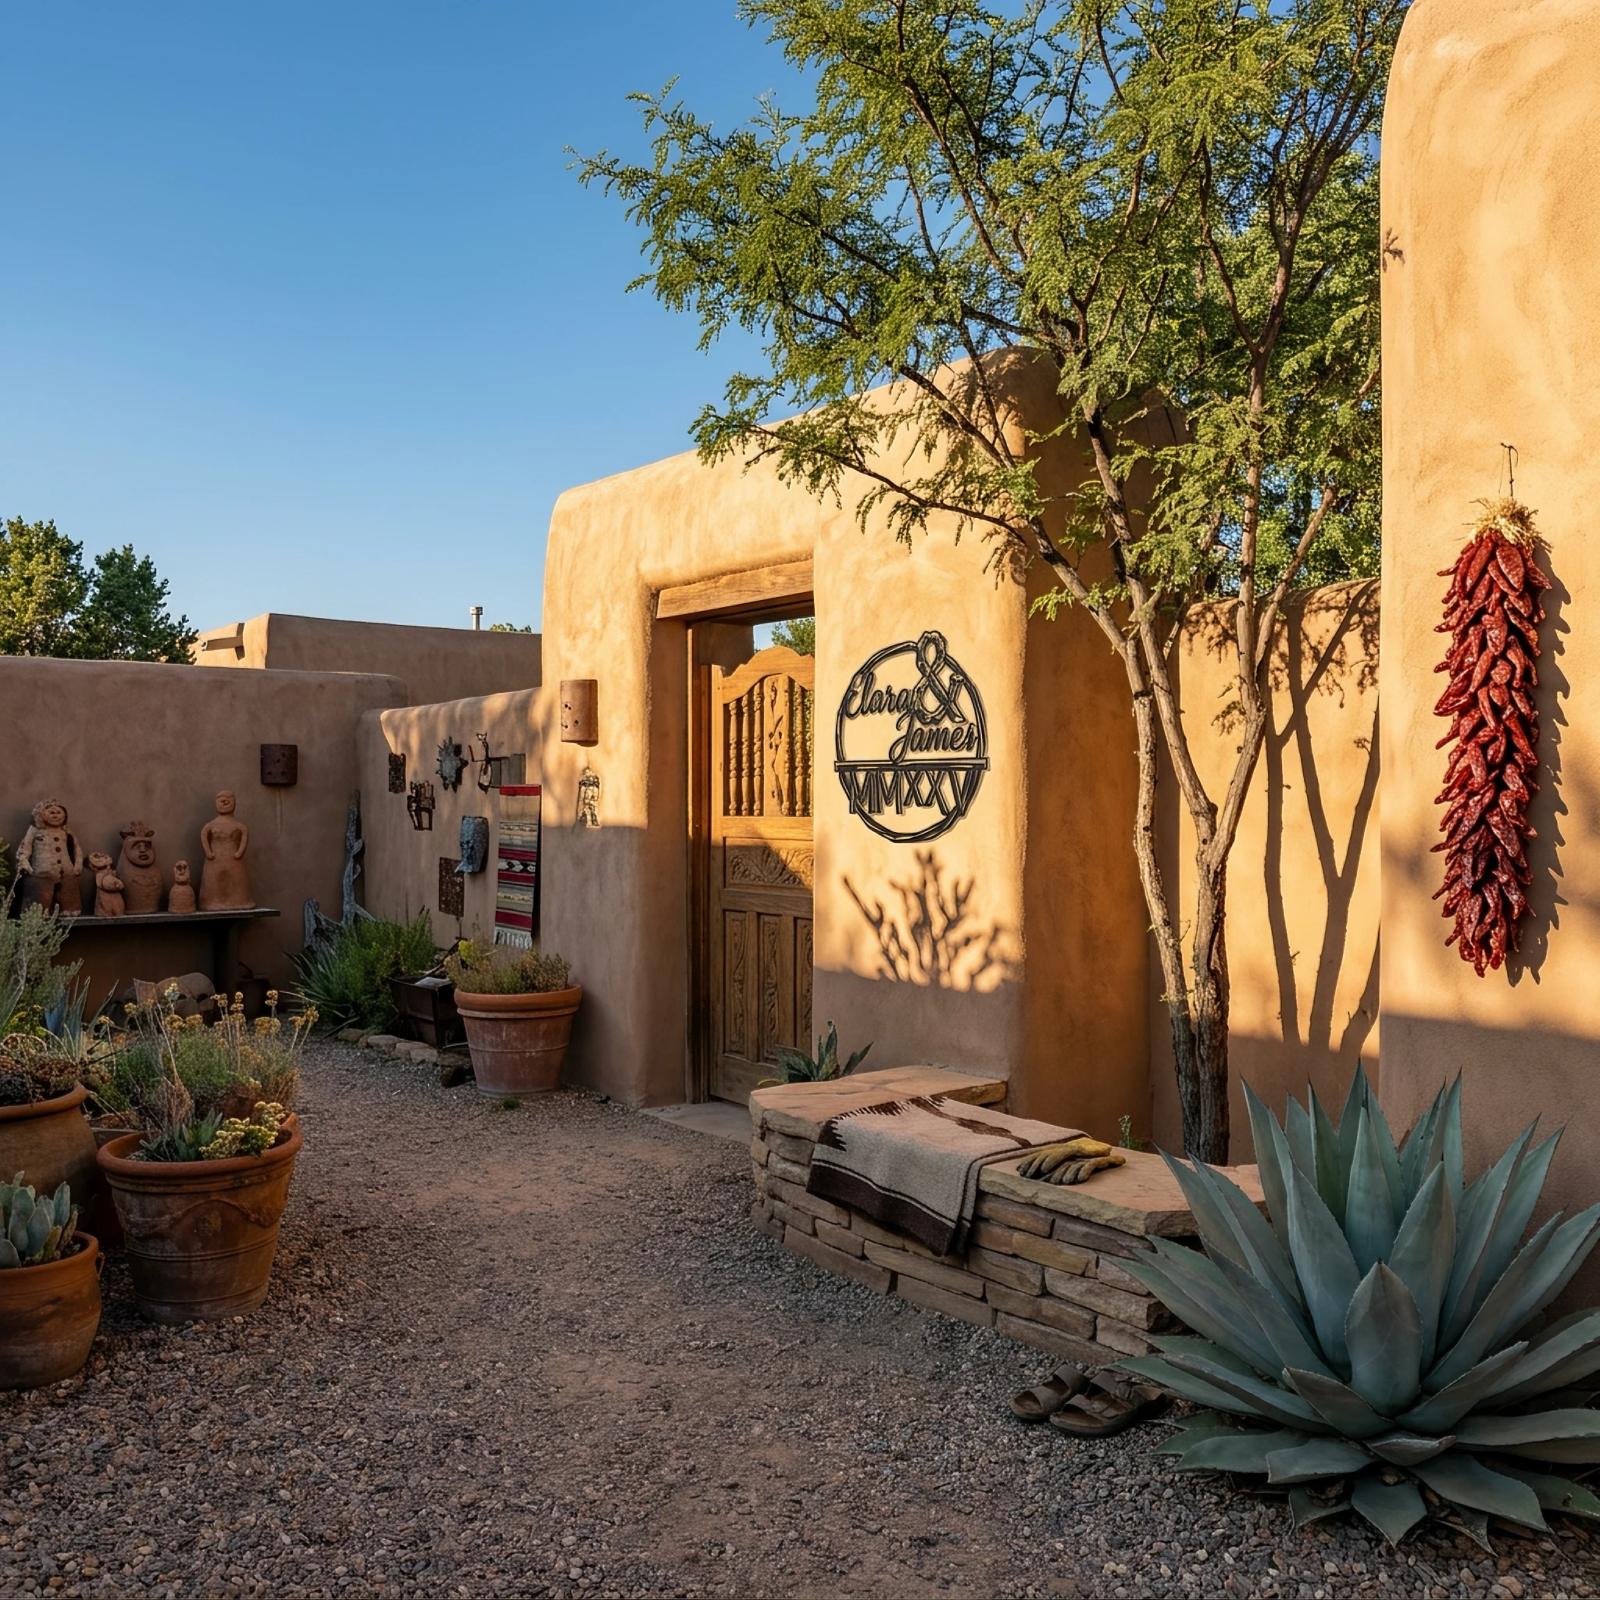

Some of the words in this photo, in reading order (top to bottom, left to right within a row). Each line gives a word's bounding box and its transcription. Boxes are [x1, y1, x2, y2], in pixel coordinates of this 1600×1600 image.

[915, 630, 966, 725] &
[888, 709, 978, 763] James
[846, 767, 978, 816] MMXXV
